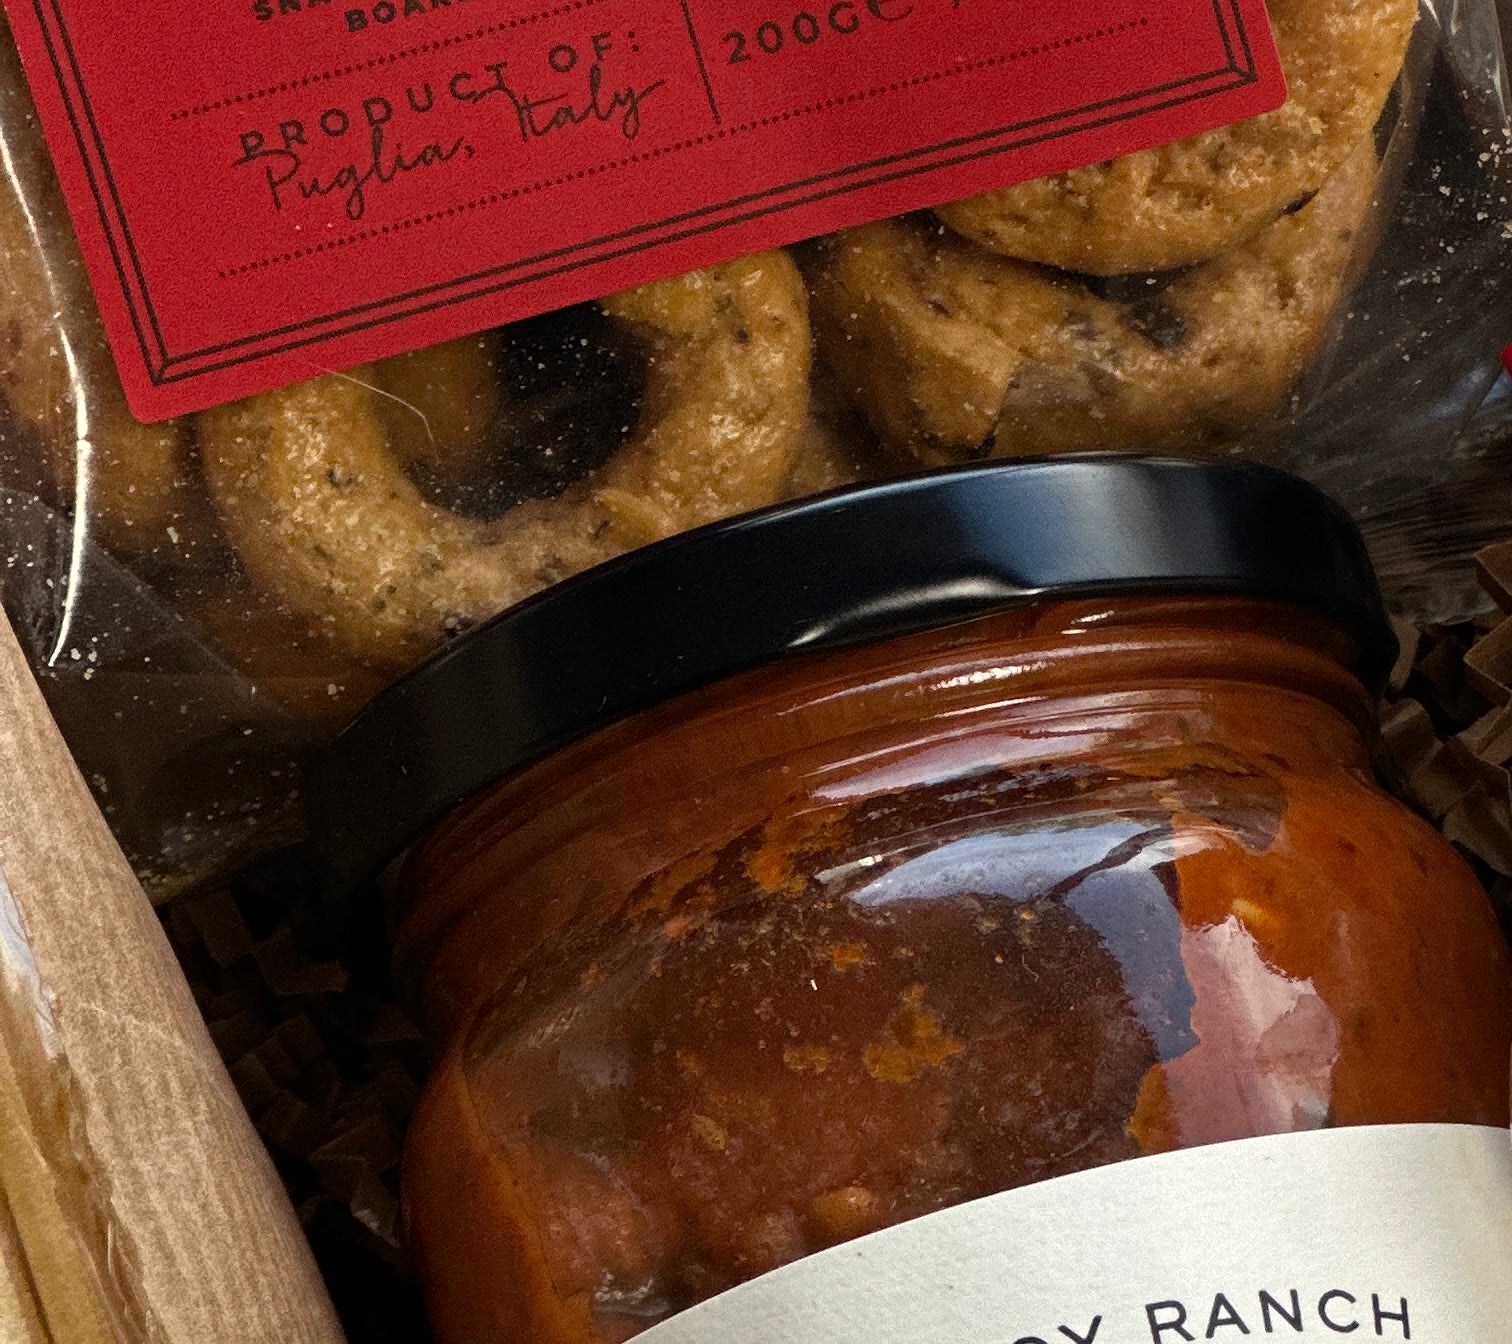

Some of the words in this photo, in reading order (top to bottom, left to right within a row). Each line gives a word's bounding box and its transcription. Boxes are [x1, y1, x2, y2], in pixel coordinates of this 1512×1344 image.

[232, 122, 476, 221] Puglia,
[473, 60, 666, 143] Italy
[239, 60, 508, 158] PRODUCT
[547, 30, 641, 74] OF:
